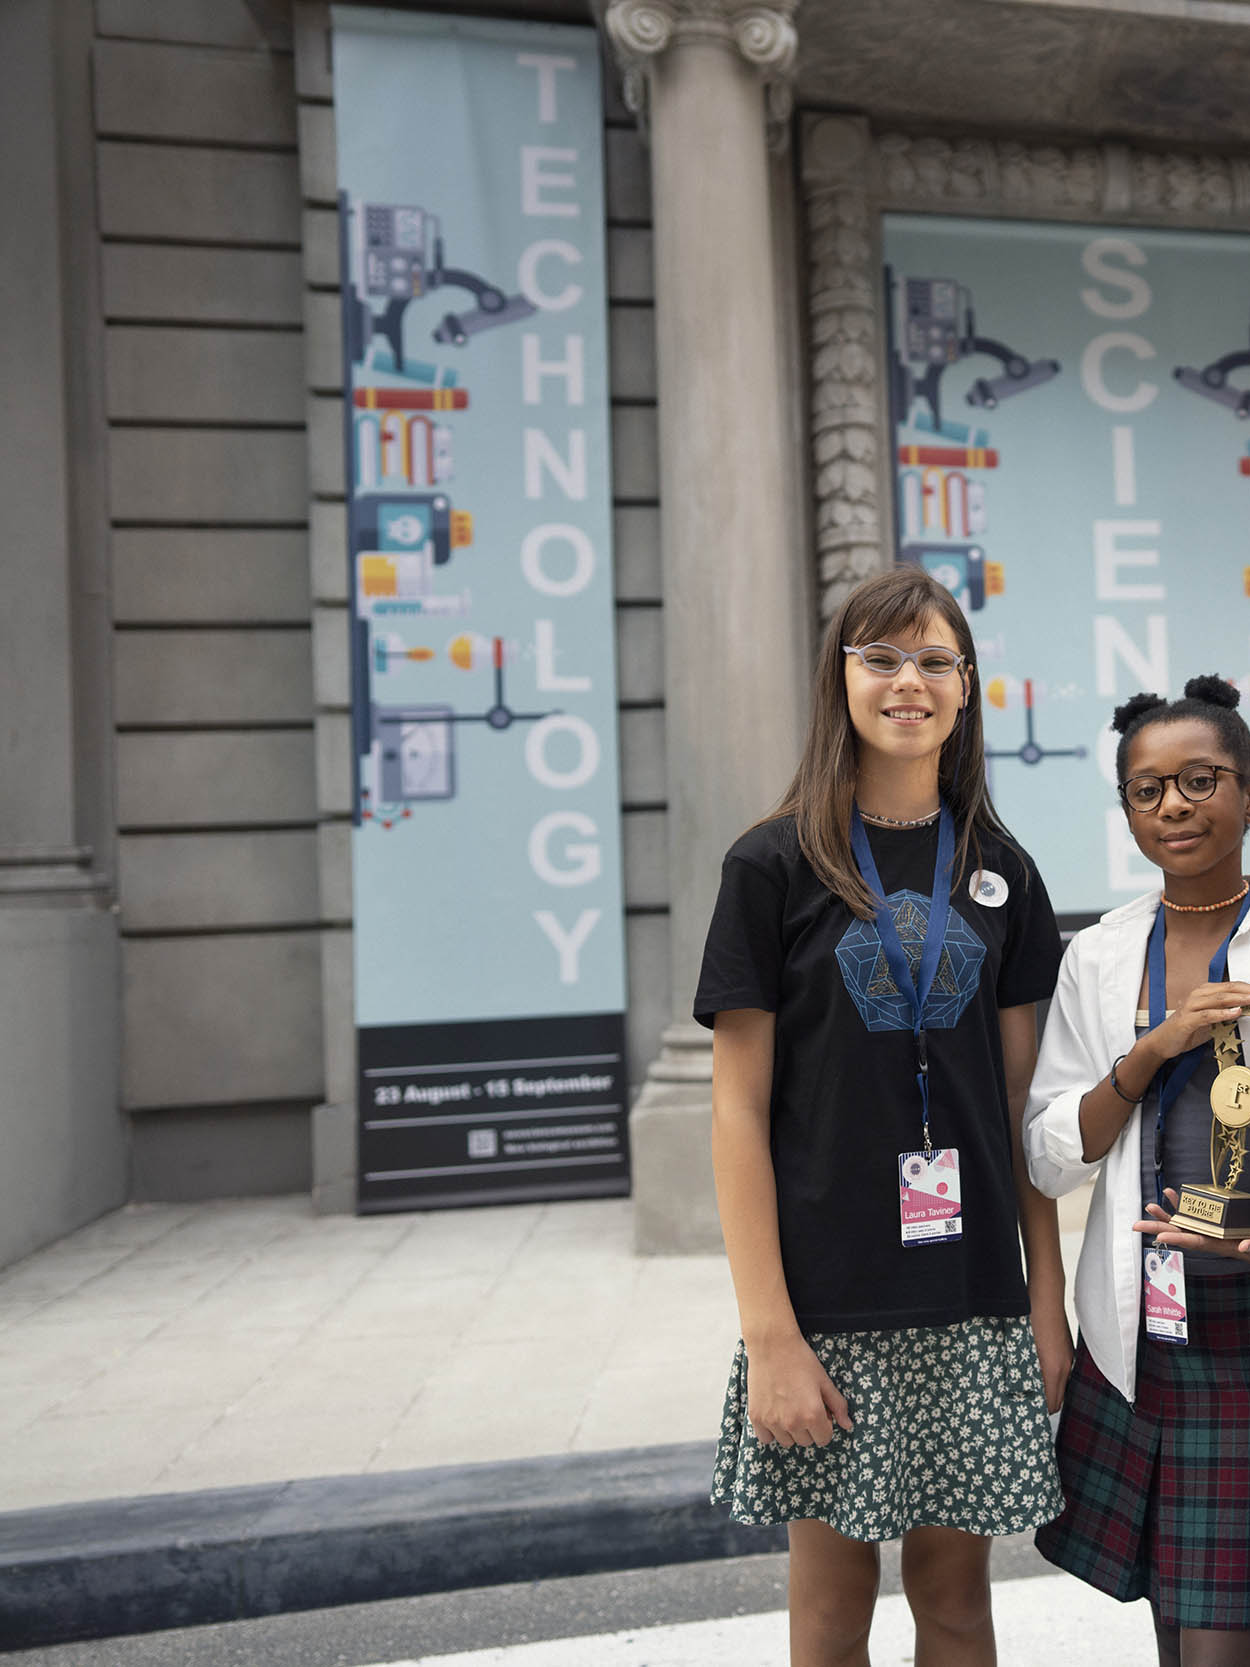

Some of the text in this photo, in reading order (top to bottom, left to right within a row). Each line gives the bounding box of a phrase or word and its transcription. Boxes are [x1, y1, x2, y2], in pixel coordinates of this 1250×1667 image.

[516, 53, 601, 986] TECHNOLOGY
[374, 1085, 400, 1106] 23
[404, 1081, 471, 1105] August
[512, 1074, 613, 1098] September
[1183, 1195, 1221, 1213] KEY TO THE
[1187, 1205, 1214, 1218] FUTURE
[904, 1207, 954, 1219] Laura Taviner
[1147, 1305, 1161, 1313] Sarah
